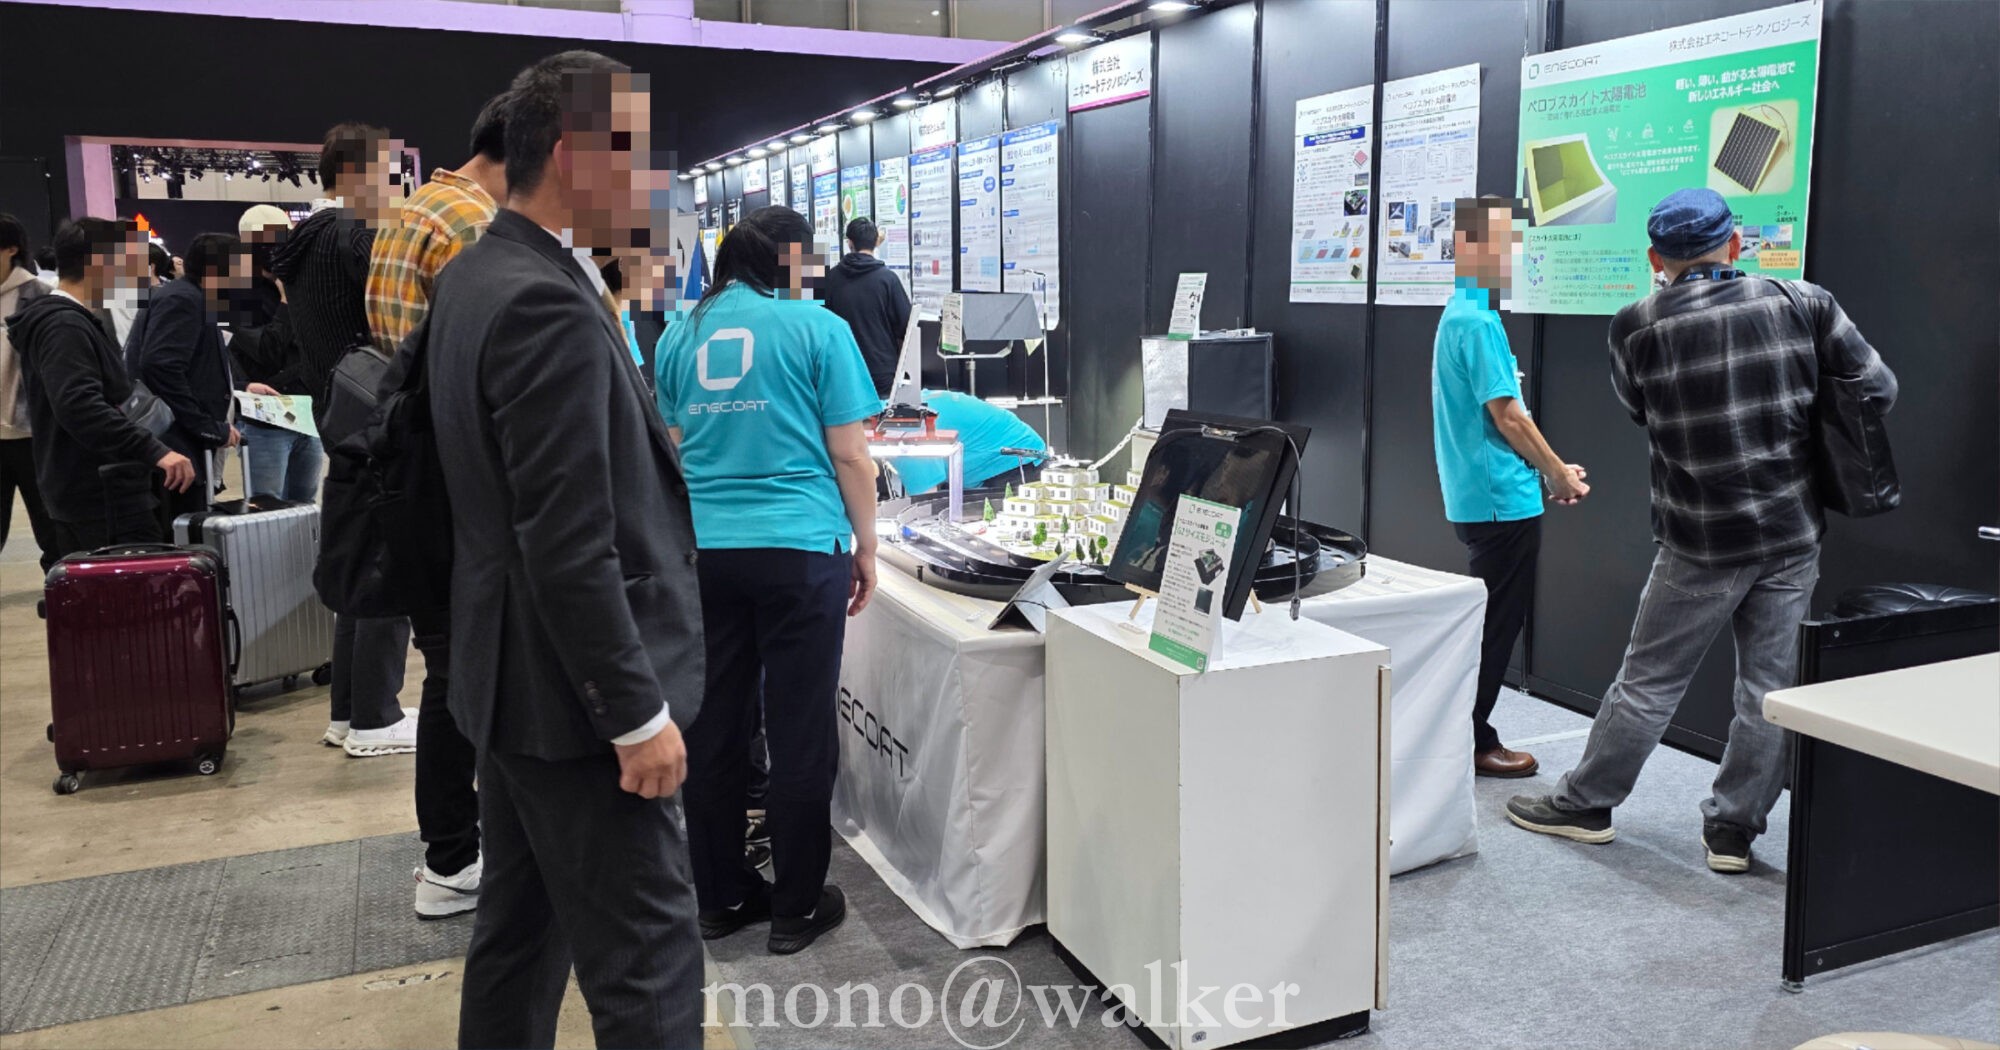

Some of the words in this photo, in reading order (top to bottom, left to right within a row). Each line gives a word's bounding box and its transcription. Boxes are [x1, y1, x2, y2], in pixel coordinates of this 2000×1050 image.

[1527, 81, 1647, 113] ペロブスカイト太陽電池
[688, 400, 769, 415] ENECOAT
[837, 687, 909, 778] ECOAT
